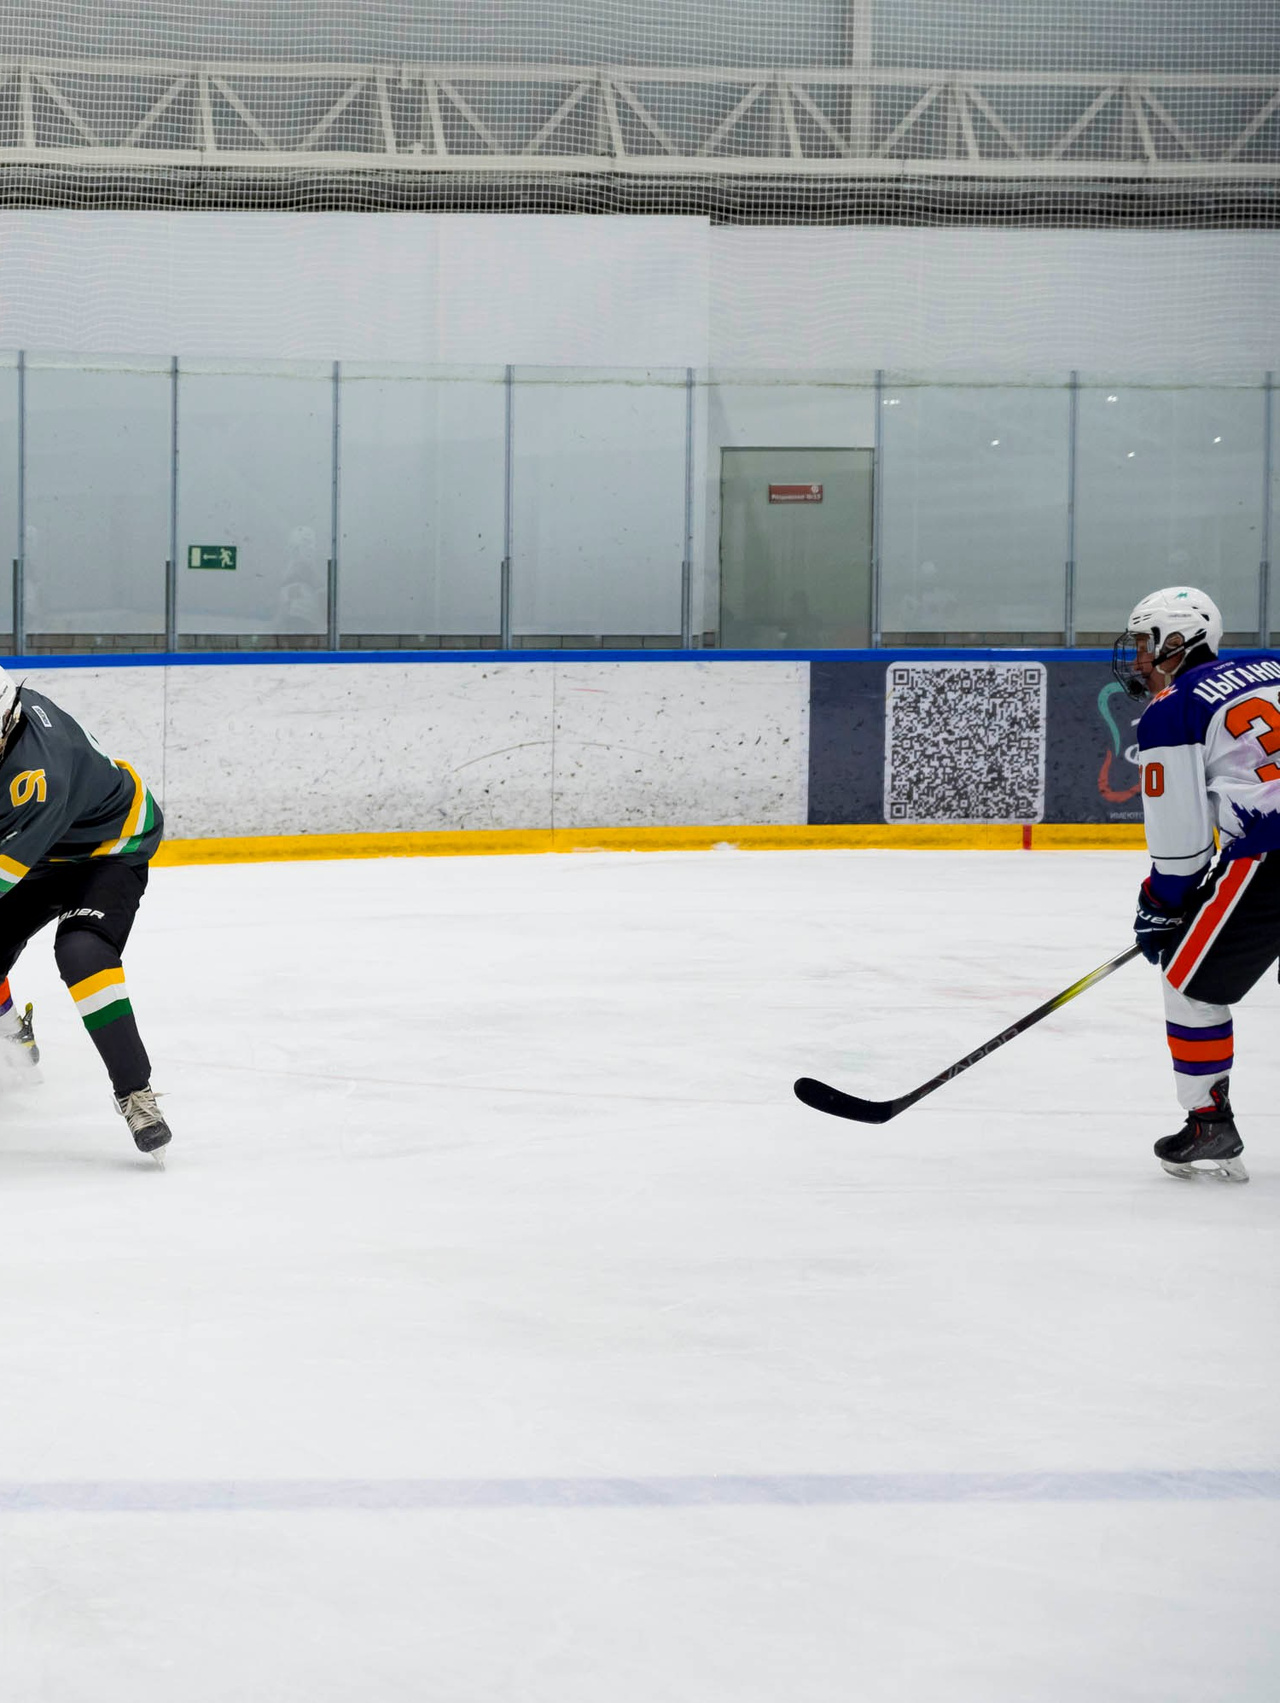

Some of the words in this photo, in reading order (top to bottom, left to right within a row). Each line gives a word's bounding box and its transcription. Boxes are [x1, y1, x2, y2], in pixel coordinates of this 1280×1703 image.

[1193, 660, 1280, 705] ЦЫГАНО
[1224, 691, 1280, 784] 3
[1139, 761, 1165, 798] 0
[58, 908, 105, 923] AUER
[1138, 909, 1184, 926] UER
